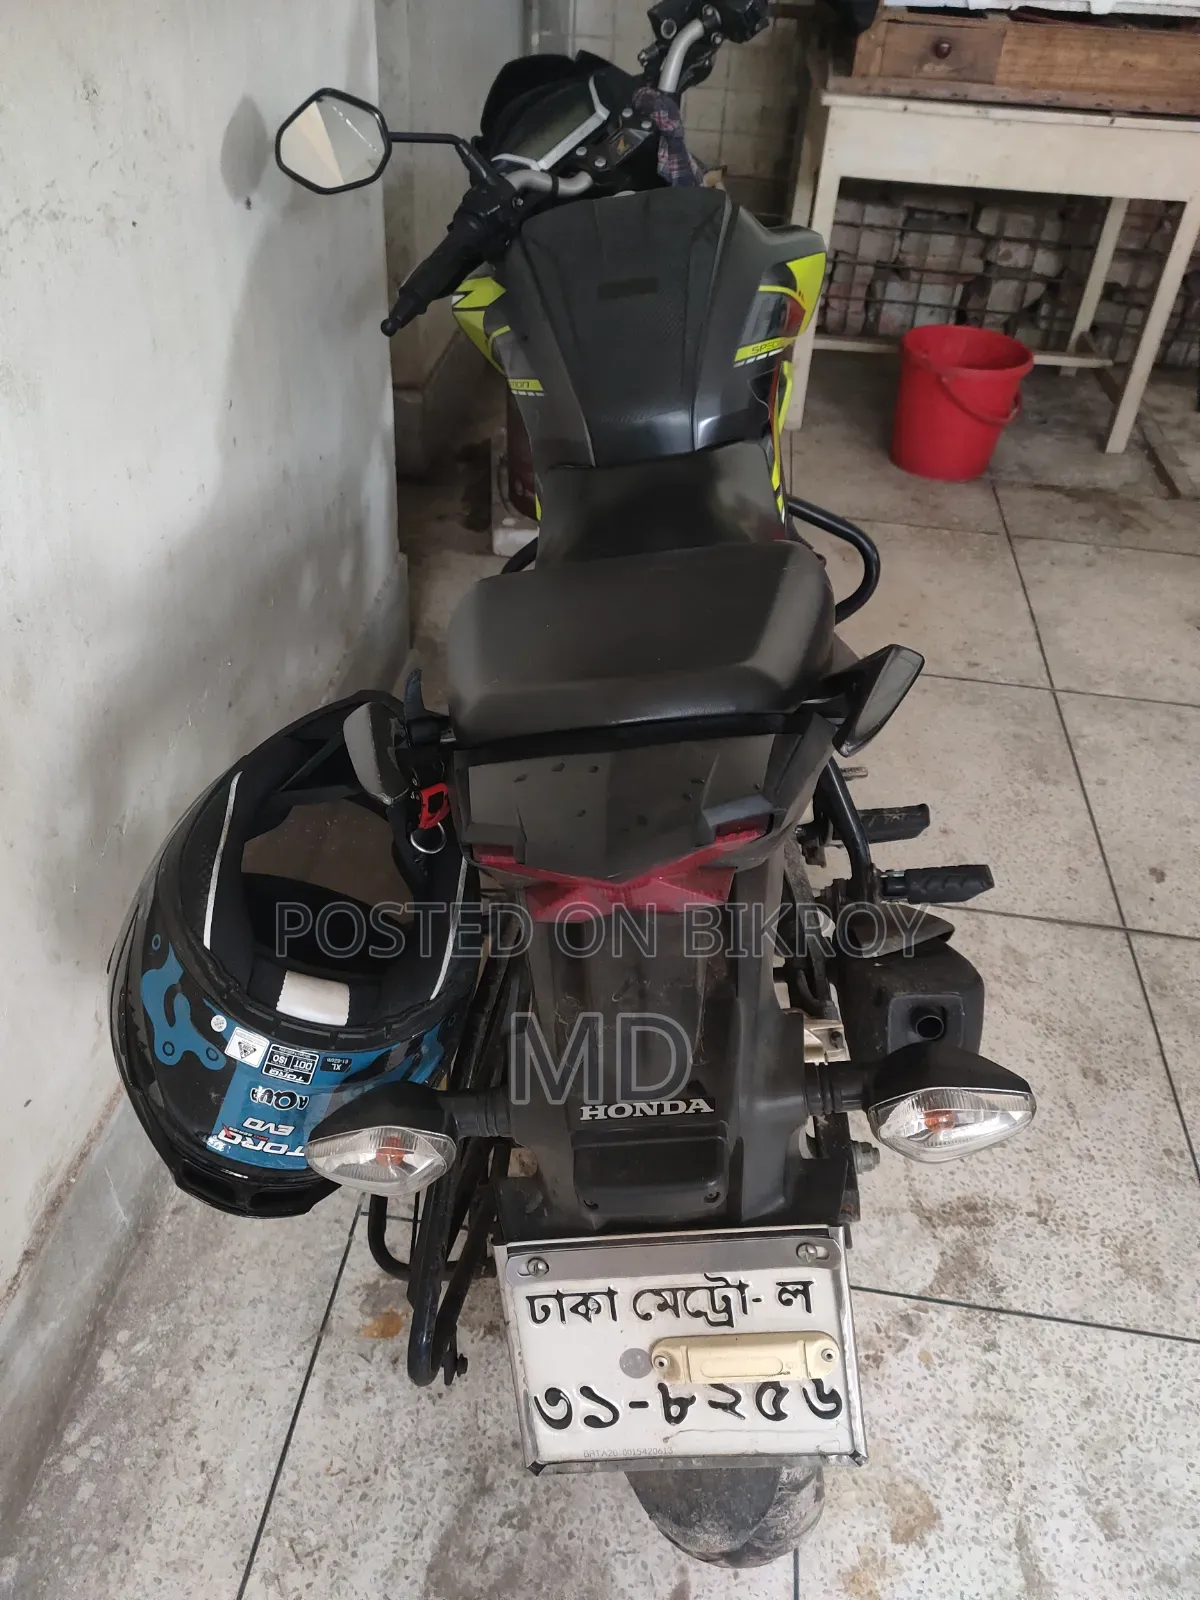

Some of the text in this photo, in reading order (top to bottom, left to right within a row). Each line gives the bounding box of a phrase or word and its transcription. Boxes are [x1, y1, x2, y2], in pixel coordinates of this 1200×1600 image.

[272, 1055, 288, 1065] ISO
[293, 1059, 312, 1071] DOT
[331, 1063, 343, 1071] XL
[580, 1097, 714, 1121] HONDA
[242, 1117, 295, 1136] EVO
[217, 1123, 305, 1157] TORQ
[526, 1286, 618, 1324] ঢাকা
[776, 1279, 817, 1314] ল
[534, 1379, 843, 1430] ৩১-৮২৫৬
